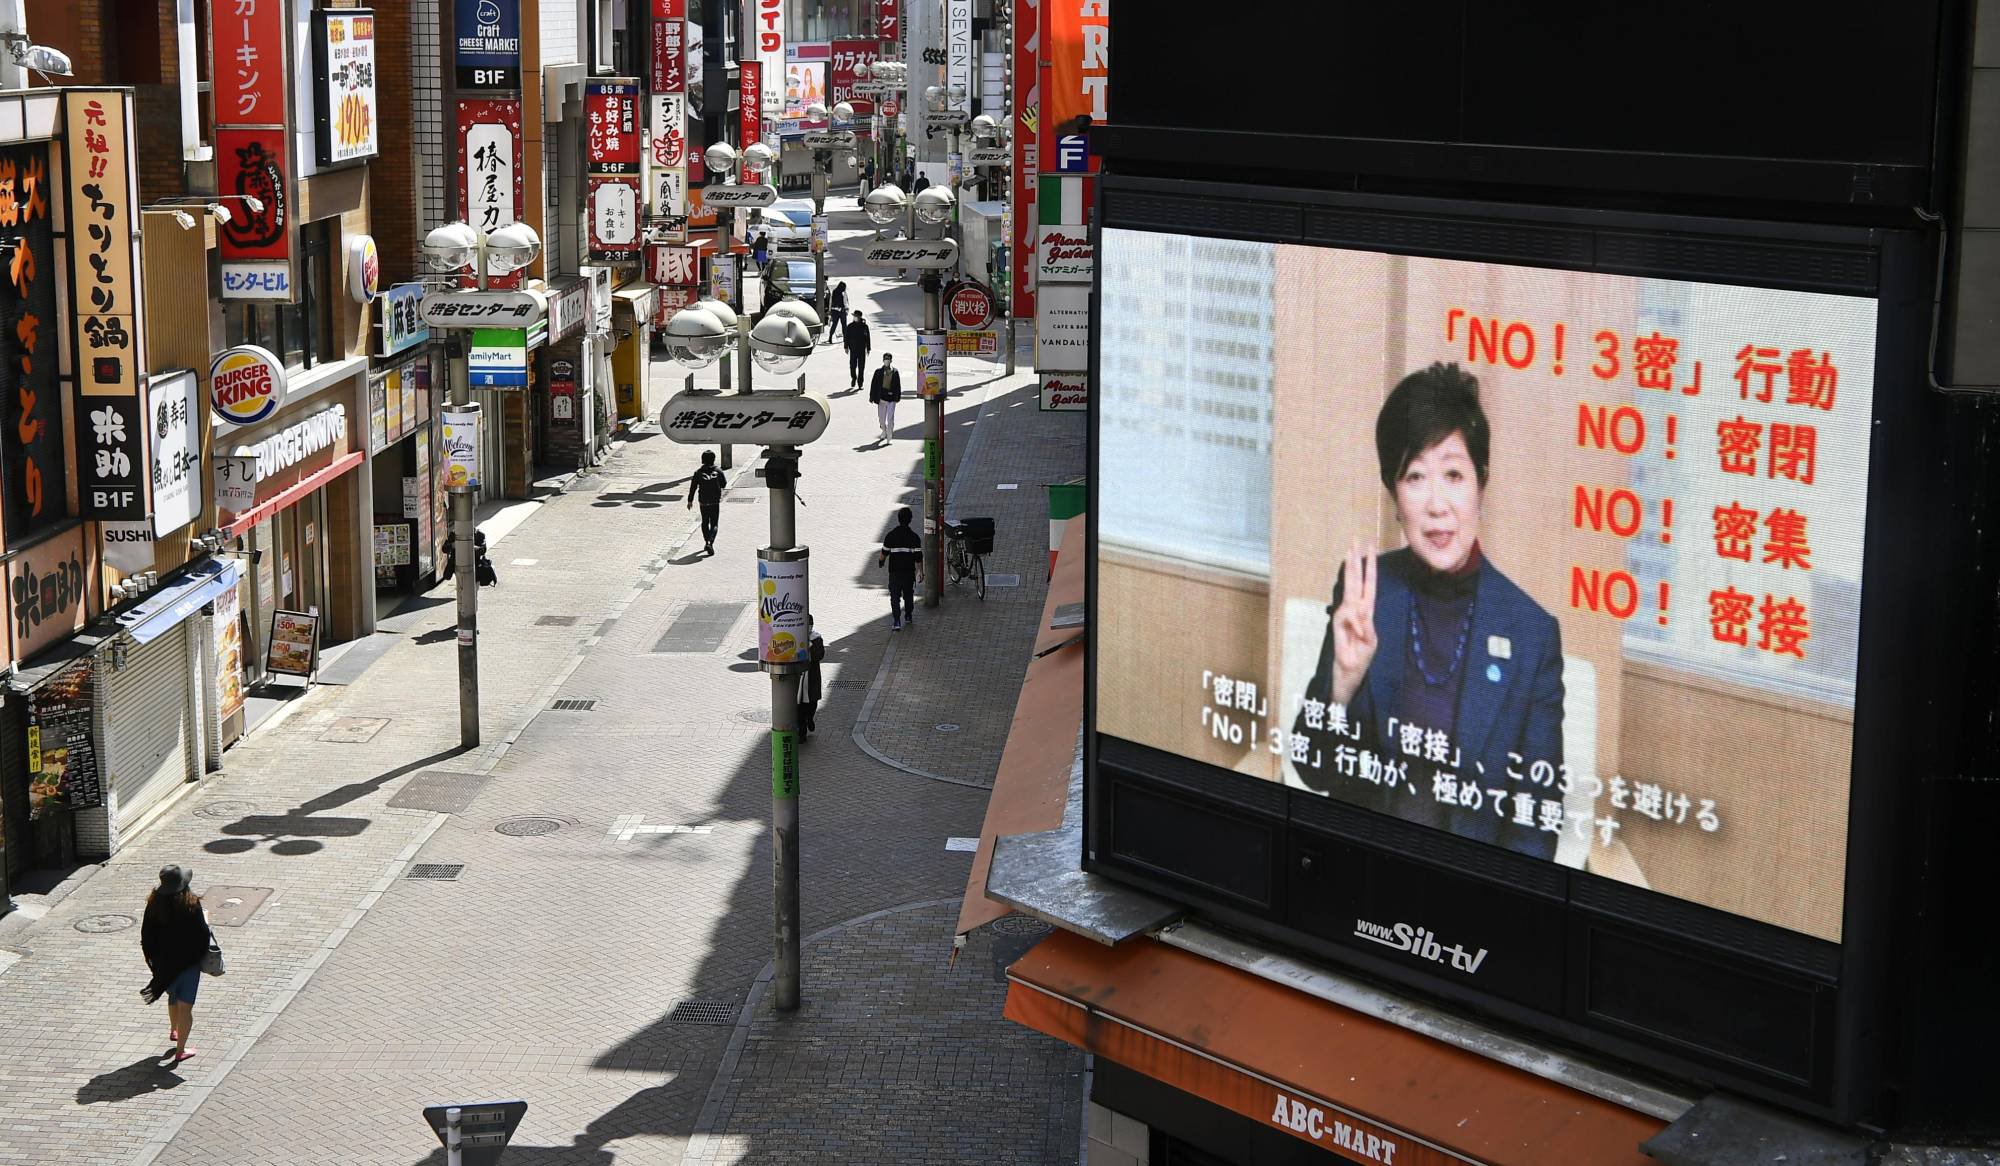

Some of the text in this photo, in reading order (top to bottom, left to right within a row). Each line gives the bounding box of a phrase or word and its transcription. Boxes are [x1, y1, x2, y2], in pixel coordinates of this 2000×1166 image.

[477, 24, 501, 38] Craft
[459, 38, 519, 51] CHEESE MARKET
[474, 70, 505, 84] B1F
[600, 85, 624, 95] 85席
[605, 97, 620, 151] お好み焼
[622, 99, 633, 132] 江戸前
[590, 111, 603, 161] もんじゃ
[617, 187, 627, 229] ケーキと
[704, 191, 770, 201] 渋谷センター街
[605, 207, 615, 240] お食事
[655, 247, 693, 283] 豚
[867, 249, 952, 260] 渋谷センター街
[224, 272, 289, 291] センタービル
[394, 295, 416, 341] 麻雀
[428, 303, 533, 317] 渋谷センター街
[954, 300, 986, 316] 消火栓
[469, 352, 512, 362] amilyMart
[214, 363, 269, 391] BURGER
[484, 374, 494, 385] 酒
[217, 377, 272, 408] KING
[170, 397, 188, 430] 寿司
[670, 410, 816, 429] 渋谷センター街
[90, 405, 131, 478] 米助
[1716, 415, 1817, 485] 密閉
[216, 459, 255, 482] すし
[93, 492, 134, 508] B1F
[105, 529, 151, 543] SUSHI
[1712, 501, 1813, 571] 密集
[1708, 585, 1811, 659] 密接
[1272, 1094, 1396, 1166] ABC-MART
